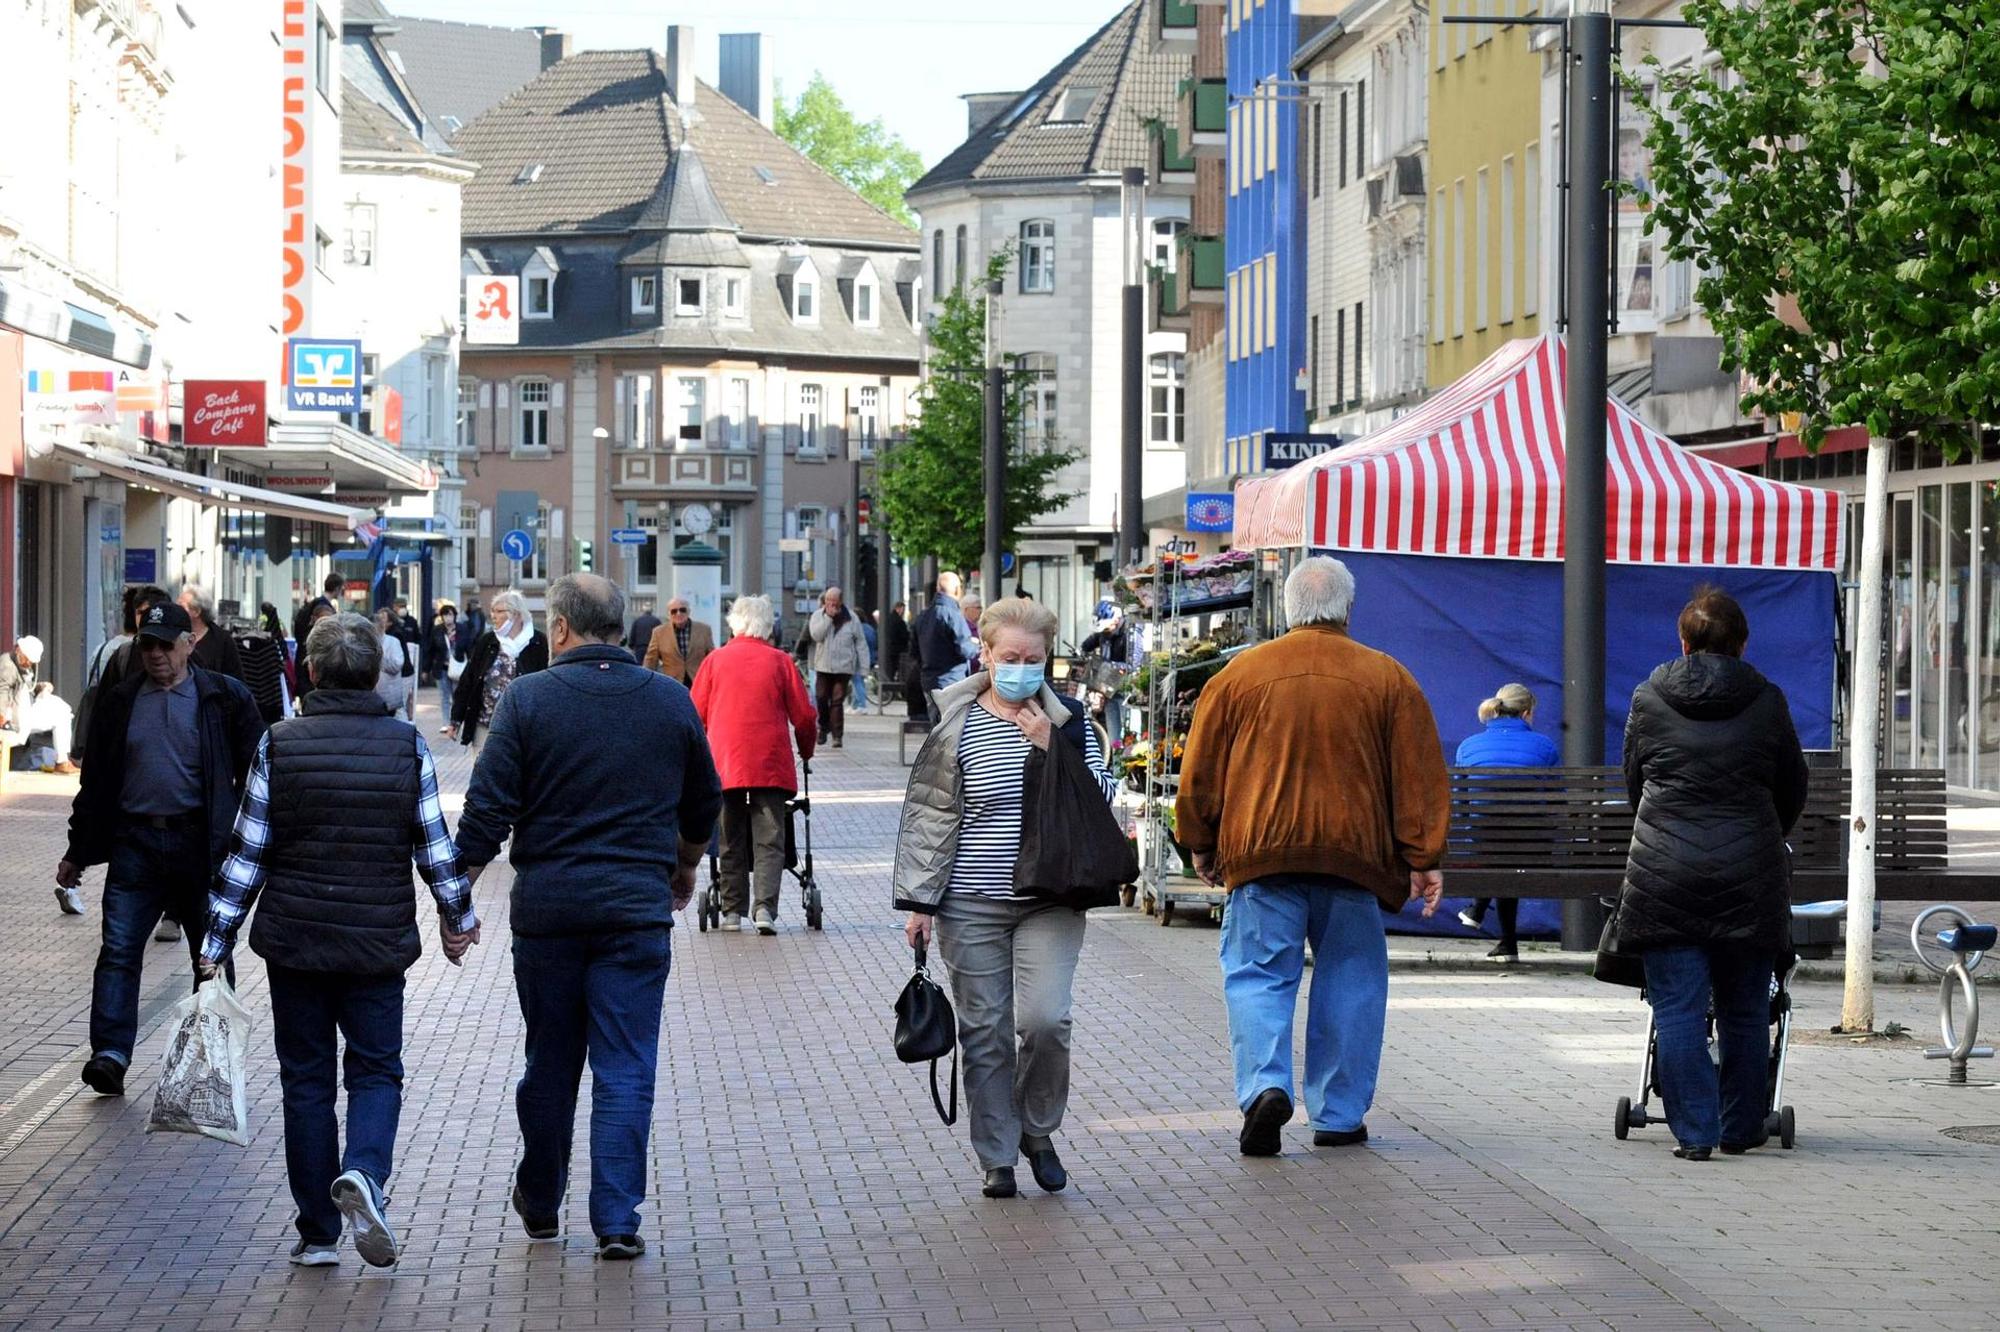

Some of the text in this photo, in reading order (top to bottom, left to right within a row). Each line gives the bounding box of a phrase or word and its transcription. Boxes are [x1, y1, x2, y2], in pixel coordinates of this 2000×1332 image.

[205, 389, 240, 408] Back
[294, 391, 355, 407] VR Bank
[193, 403, 257, 425] Company
[211, 417, 244, 436] Café
[266, 476, 332, 486] WOOLWORTH
